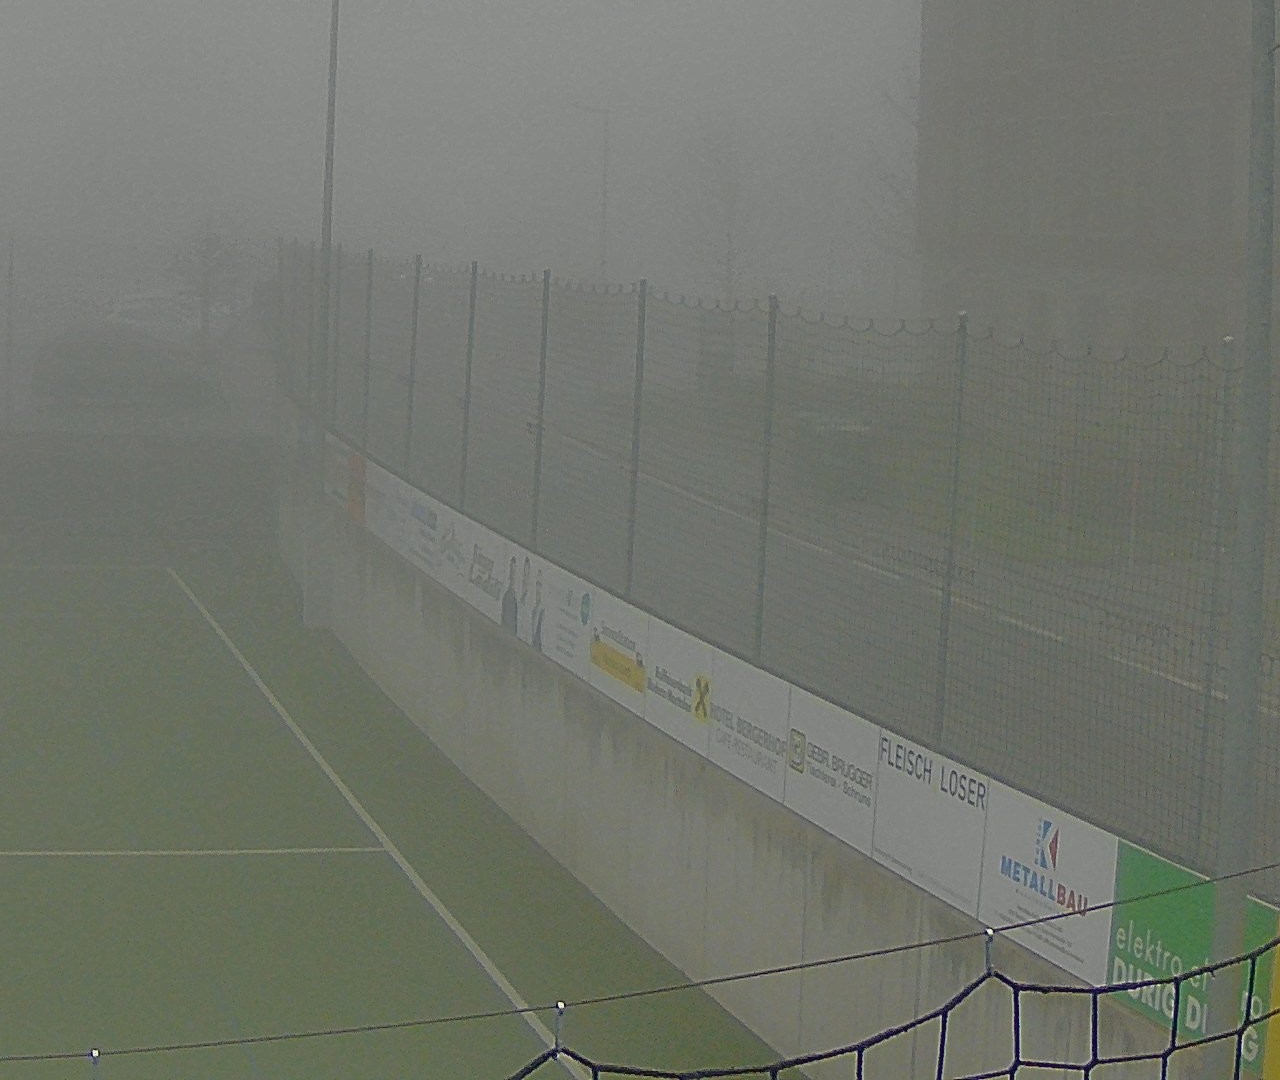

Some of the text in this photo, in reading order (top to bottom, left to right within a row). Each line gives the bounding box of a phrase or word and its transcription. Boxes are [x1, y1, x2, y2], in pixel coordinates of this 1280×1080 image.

[880, 736, 987, 811] FLEISCH LOSER
[1000, 855, 1089, 918] METALLBAU
[1116, 919, 1183, 976] elektro
